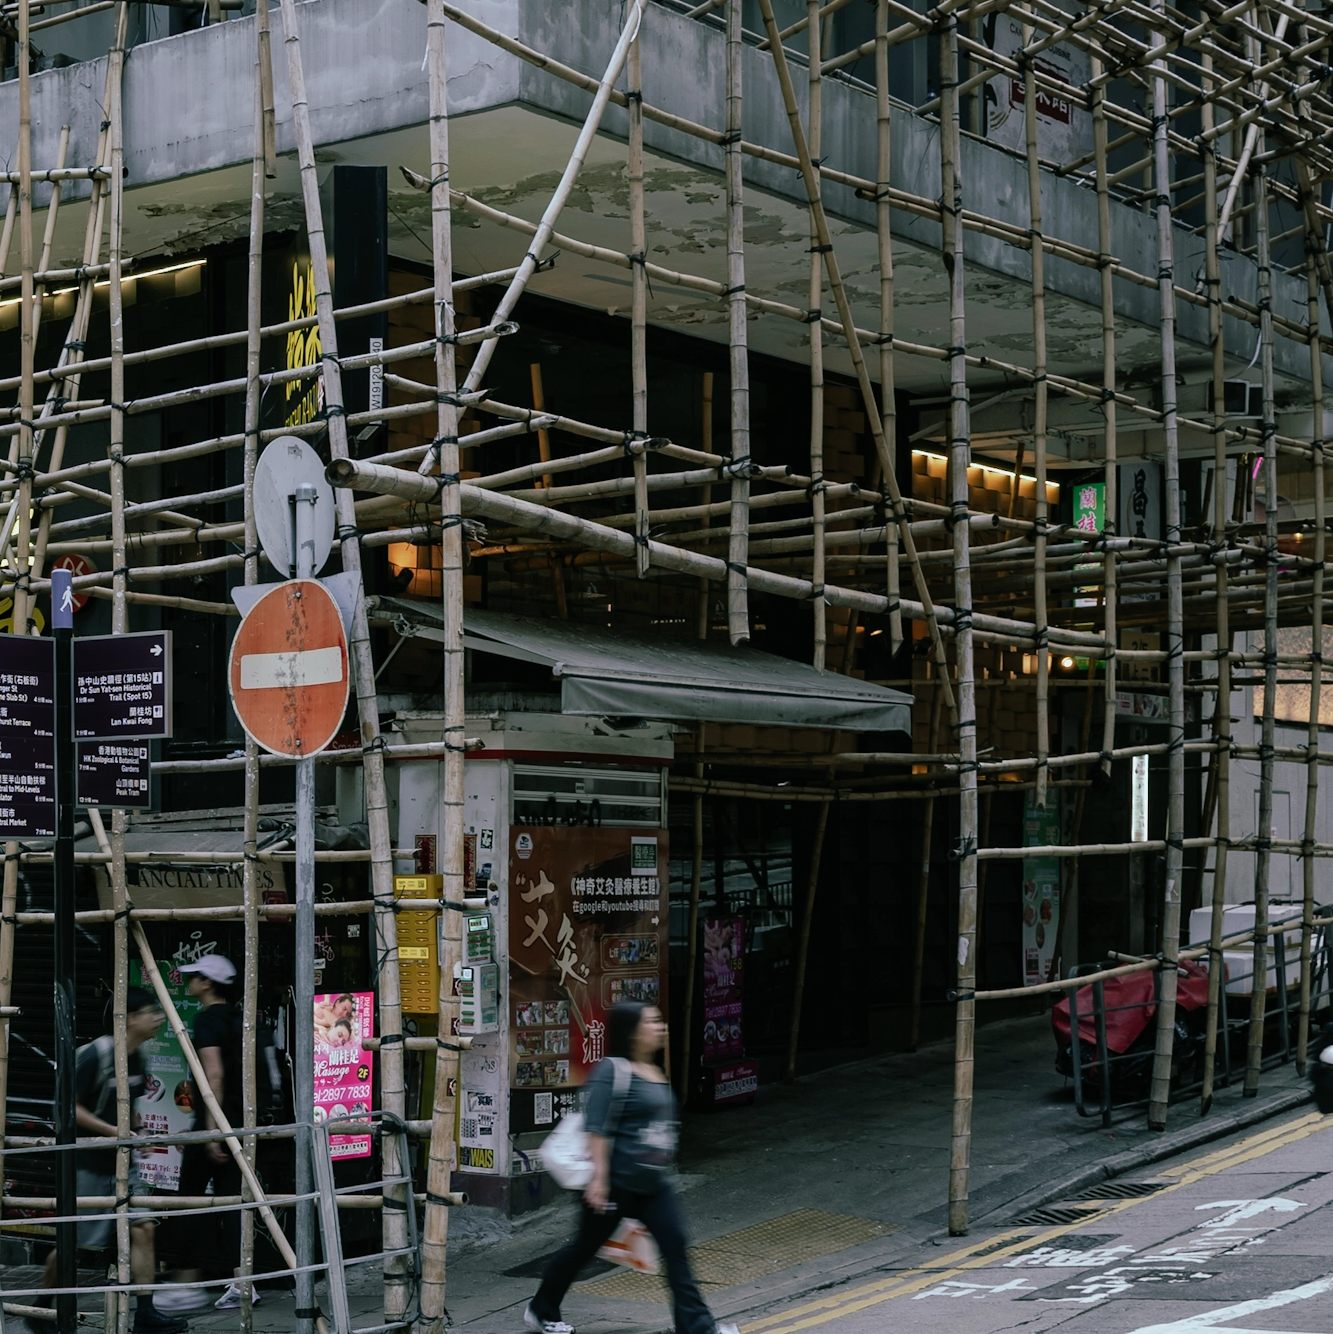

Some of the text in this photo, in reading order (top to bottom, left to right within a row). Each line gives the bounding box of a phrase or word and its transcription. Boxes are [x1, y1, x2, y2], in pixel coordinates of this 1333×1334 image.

[90, 686, 102, 694] Sun
[124, 683, 152, 691] Historical
[110, 691, 152, 701] Trail (Spot 15)
[13, 718, 31, 727] Terrace
[123, 718, 137, 726] Kwai
[138, 718, 152, 727] Fong
[9, 785, 14, 793] to
[9, 819, 27, 827] Market
[357, 1067, 369, 1080] 2F
[313, 1084, 370, 1104] el:2897 7833
[470, 1148, 494, 1169] WAIS
